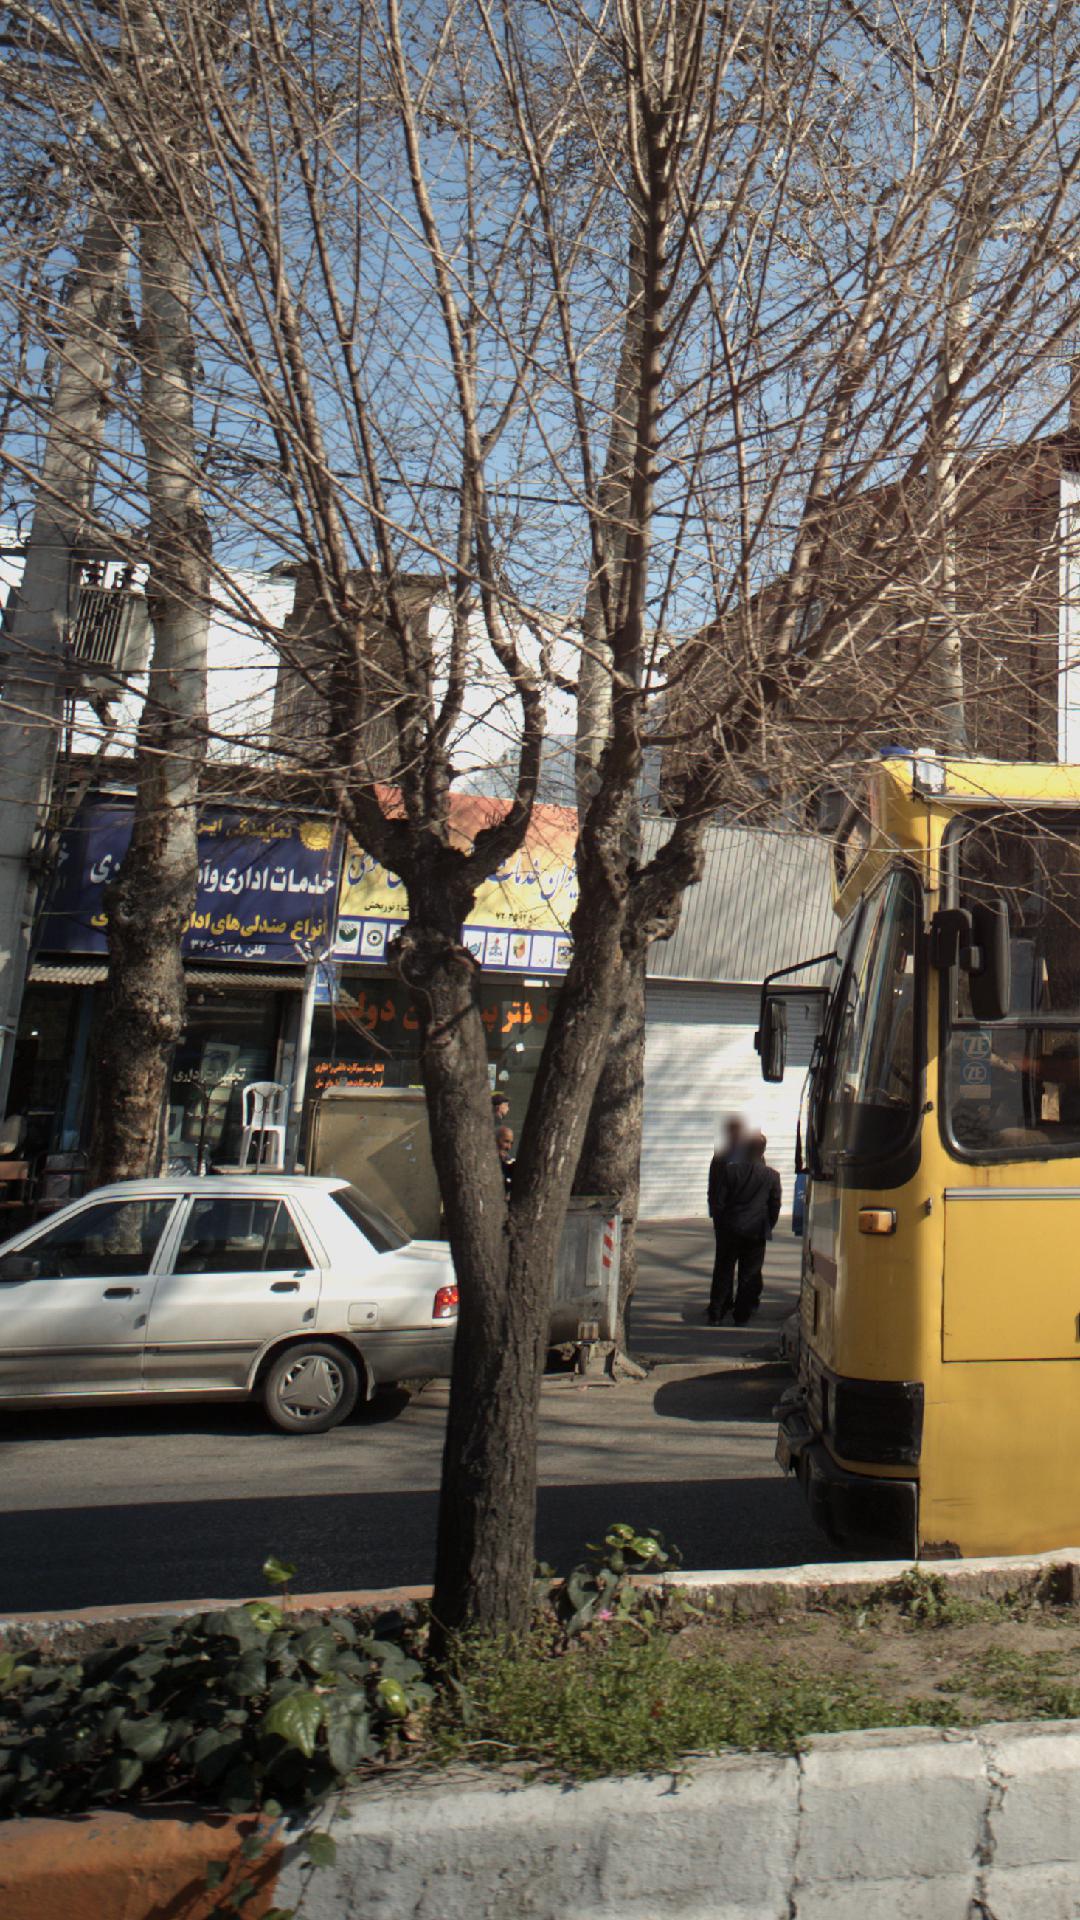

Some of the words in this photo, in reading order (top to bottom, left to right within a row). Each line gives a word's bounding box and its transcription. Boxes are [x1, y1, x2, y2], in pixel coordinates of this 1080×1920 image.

[219, 865, 269, 895] اداری
[270, 866, 335, 895] خدمات
[180, 911, 211, 934] ادار
[240, 914, 288, 937] صندلی
[290, 917, 328, 942] انواع
[244, 944, 267, 958] تلفن
[501, 1000, 549, 1033] دفتر
